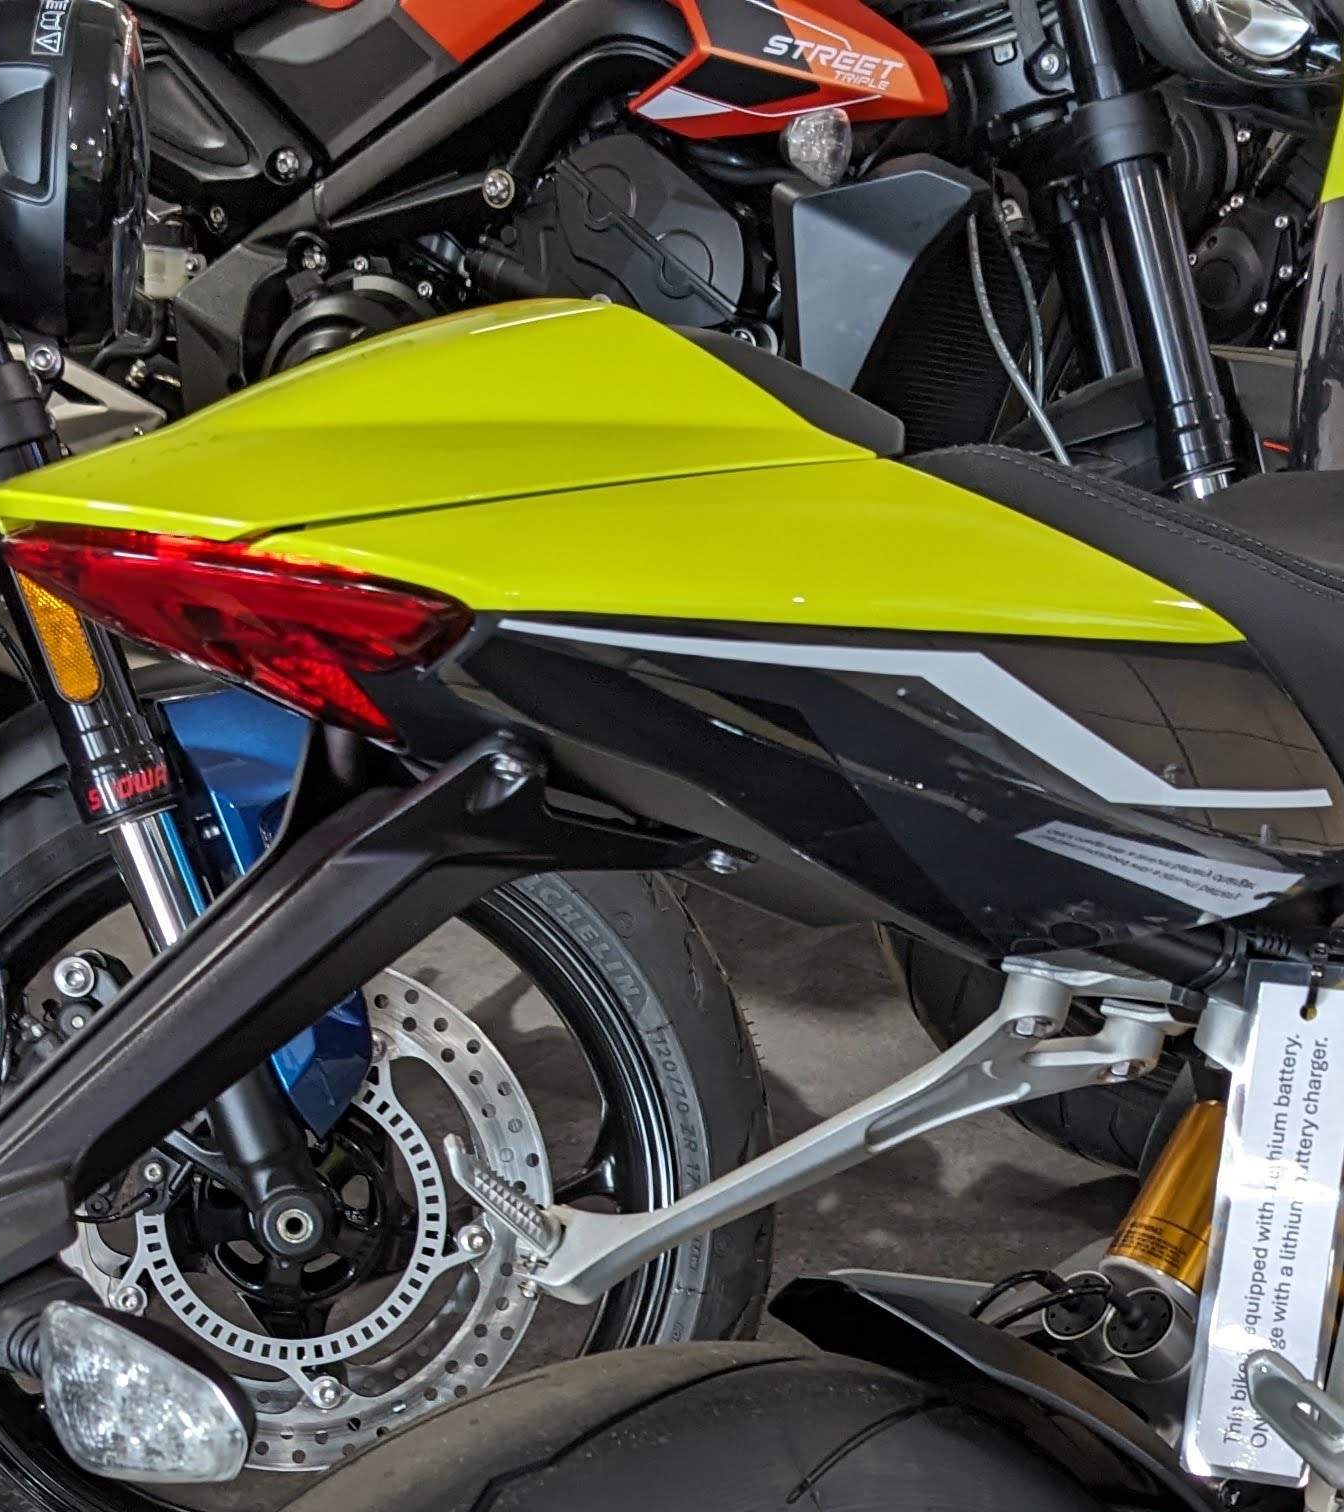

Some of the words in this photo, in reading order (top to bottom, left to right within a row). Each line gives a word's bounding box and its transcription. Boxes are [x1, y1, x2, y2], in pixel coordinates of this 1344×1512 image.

[762, 34, 905, 80] STREET
[834, 70, 890, 91] TRIPLE
[86, 764, 168, 813] SOWA
[522, 874, 642, 998] ICHELIN
[652, 1033, 691, 1114] 120/70
[1273, 1033, 1303, 1108] battery.
[1302, 1036, 1329, 1116] charger.
[679, 1121, 699, 1156] ZR
[1264, 1116, 1289, 1180] hium
[685, 1161, 702, 1187] 17
[1255, 1201, 1276, 1243] with
[1244, 1246, 1269, 1335] equipped
[1280, 1265, 1295, 1278] a
[1270, 1283, 1291, 1323] with
[1223, 1405, 1244, 1444] This
